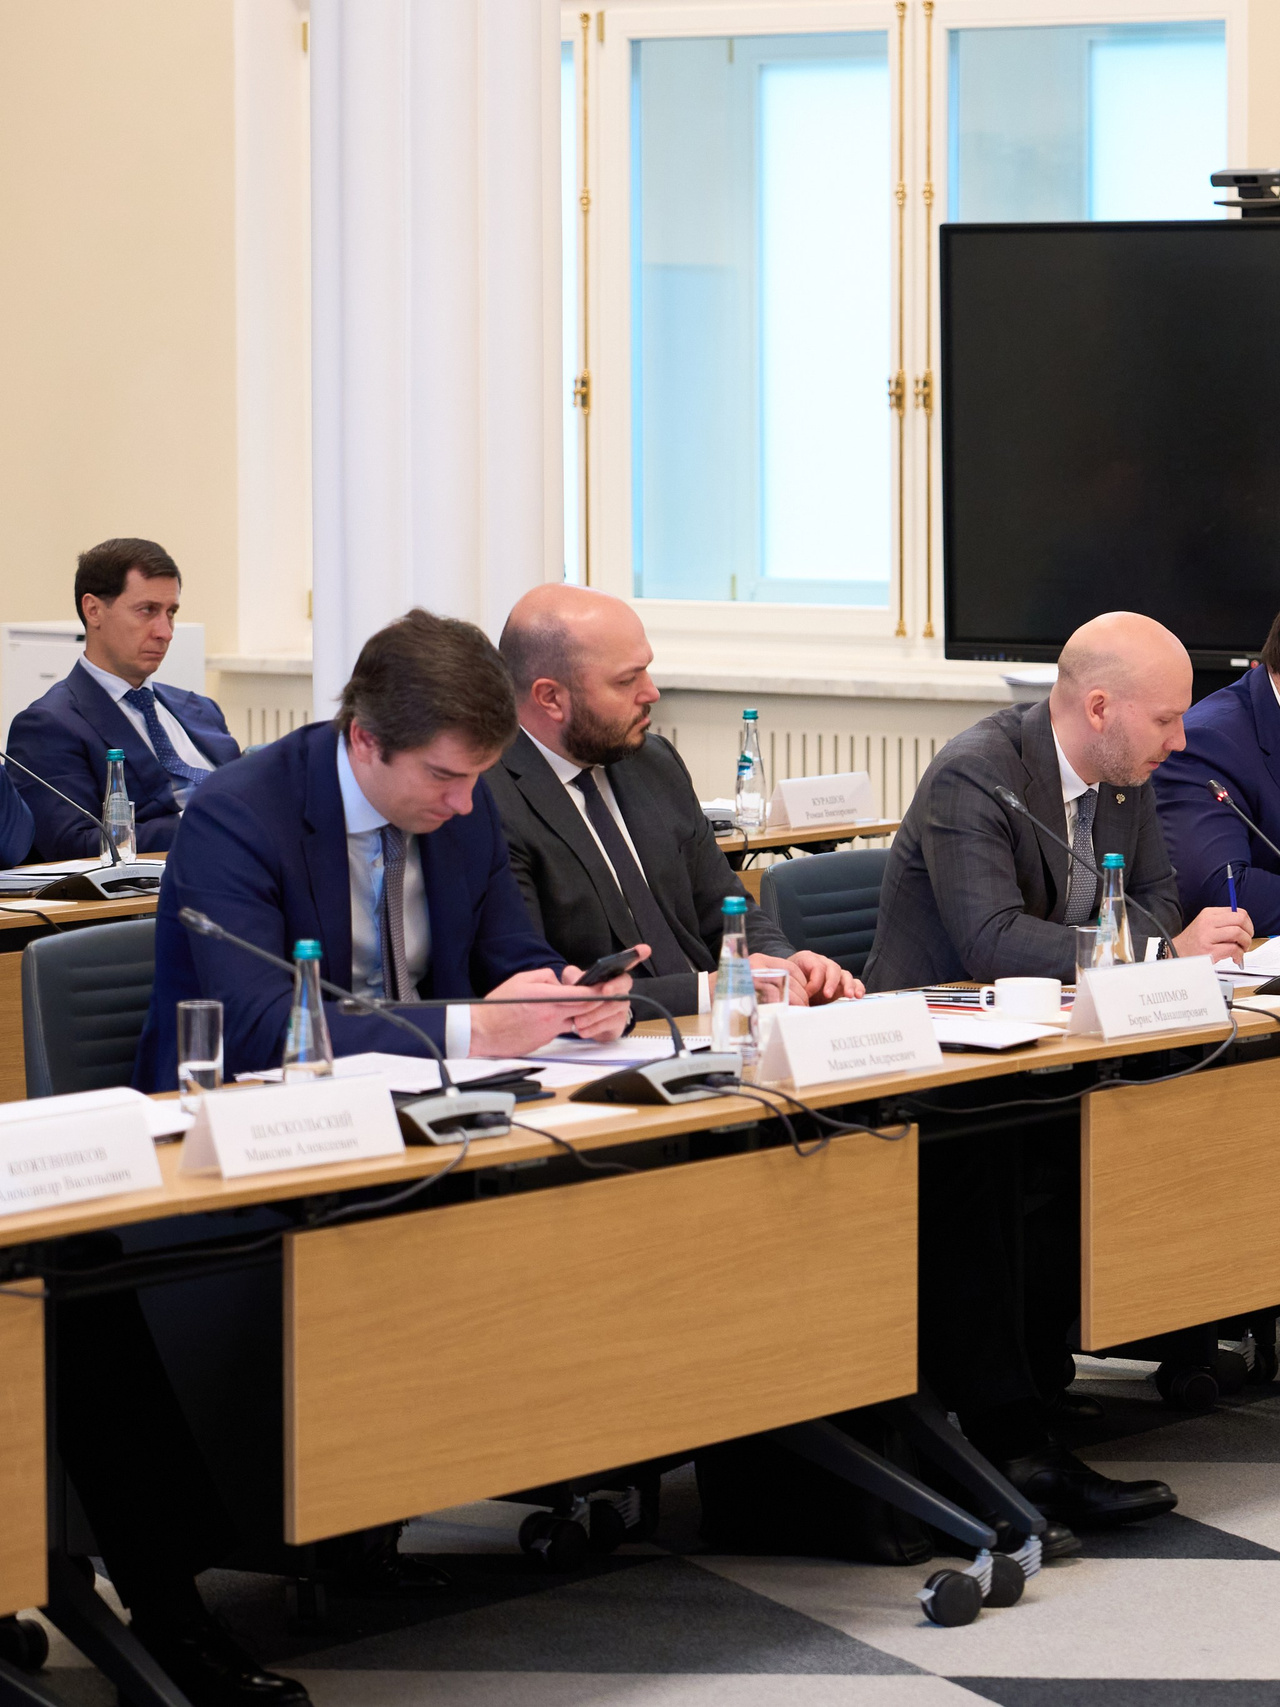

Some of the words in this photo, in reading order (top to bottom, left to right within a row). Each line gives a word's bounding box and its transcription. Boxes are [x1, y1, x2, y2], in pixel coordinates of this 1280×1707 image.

[1139, 990, 1189, 1005] ТАШИМОВ
[1128, 1014, 1153, 1027] Борис
[1154, 1007, 1208, 1022] Манаширович
[831, 1030, 904, 1051] КОЛЕСНИКОВ
[827, 1058, 867, 1071] Максим
[870, 1050, 916, 1066] Андреевич
[251, 1110, 354, 1139] ШАСКОЛЬСКИЙ
[245, 1147, 293, 1162] Максим
[297, 1138, 360, 1155] Алексеевич
[8, 1147, 108, 1176] КОЖЕВНИКОВ
